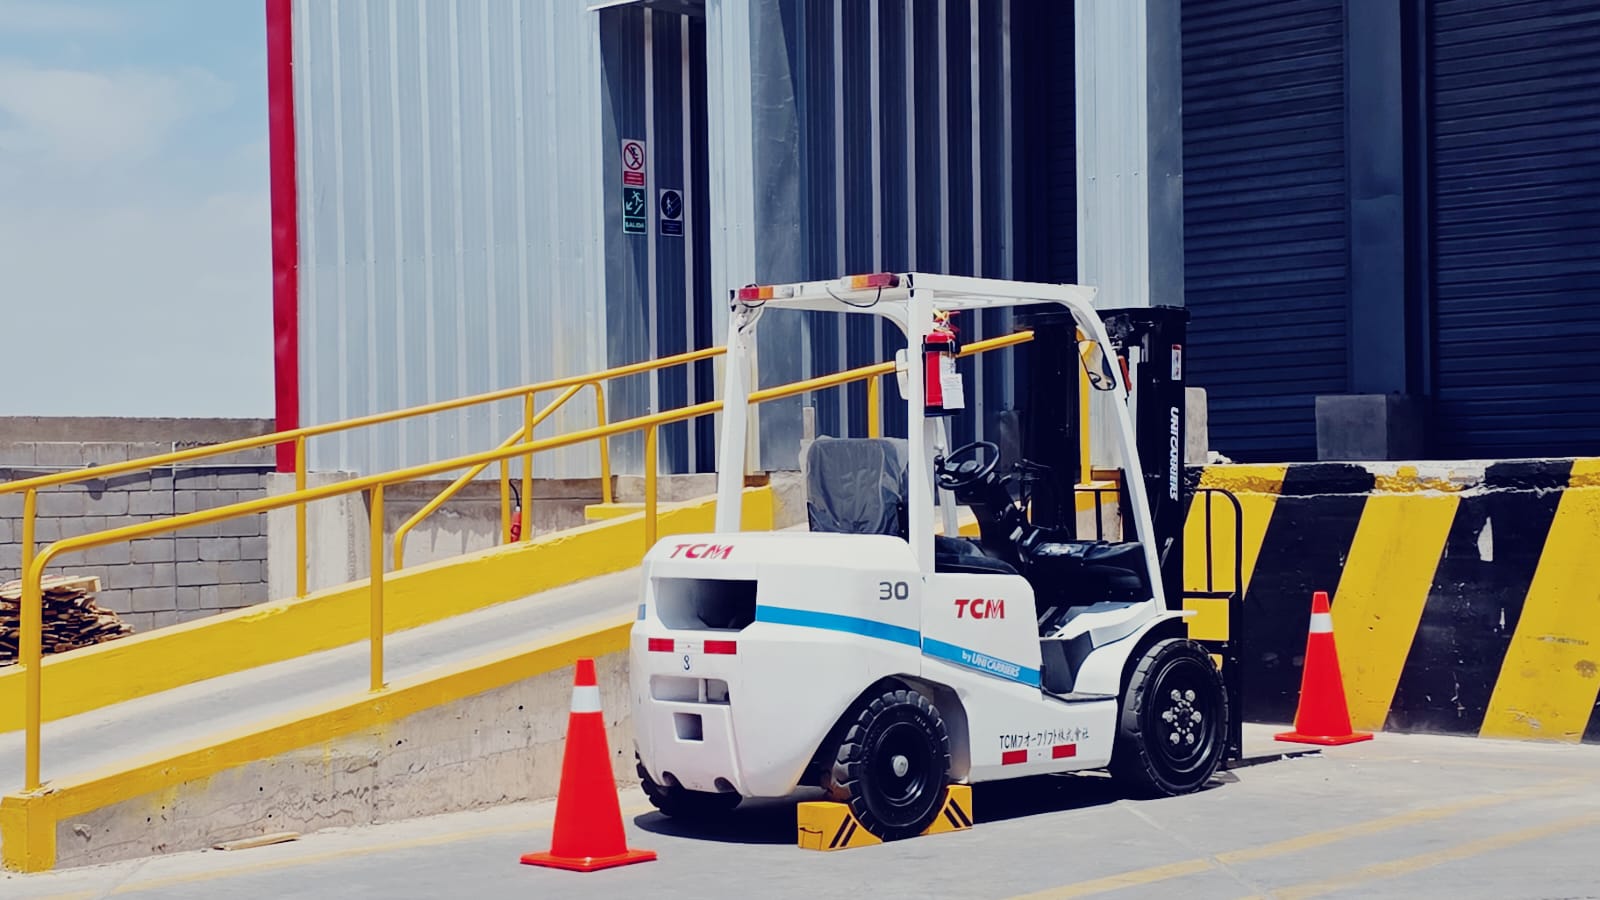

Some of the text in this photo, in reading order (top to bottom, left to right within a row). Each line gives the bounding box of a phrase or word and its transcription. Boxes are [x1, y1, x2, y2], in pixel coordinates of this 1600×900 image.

[670, 543, 735, 560] TCM
[879, 581, 909, 600] 30
[954, 598, 1005, 619] TCM
[961, 650, 972, 663] by
